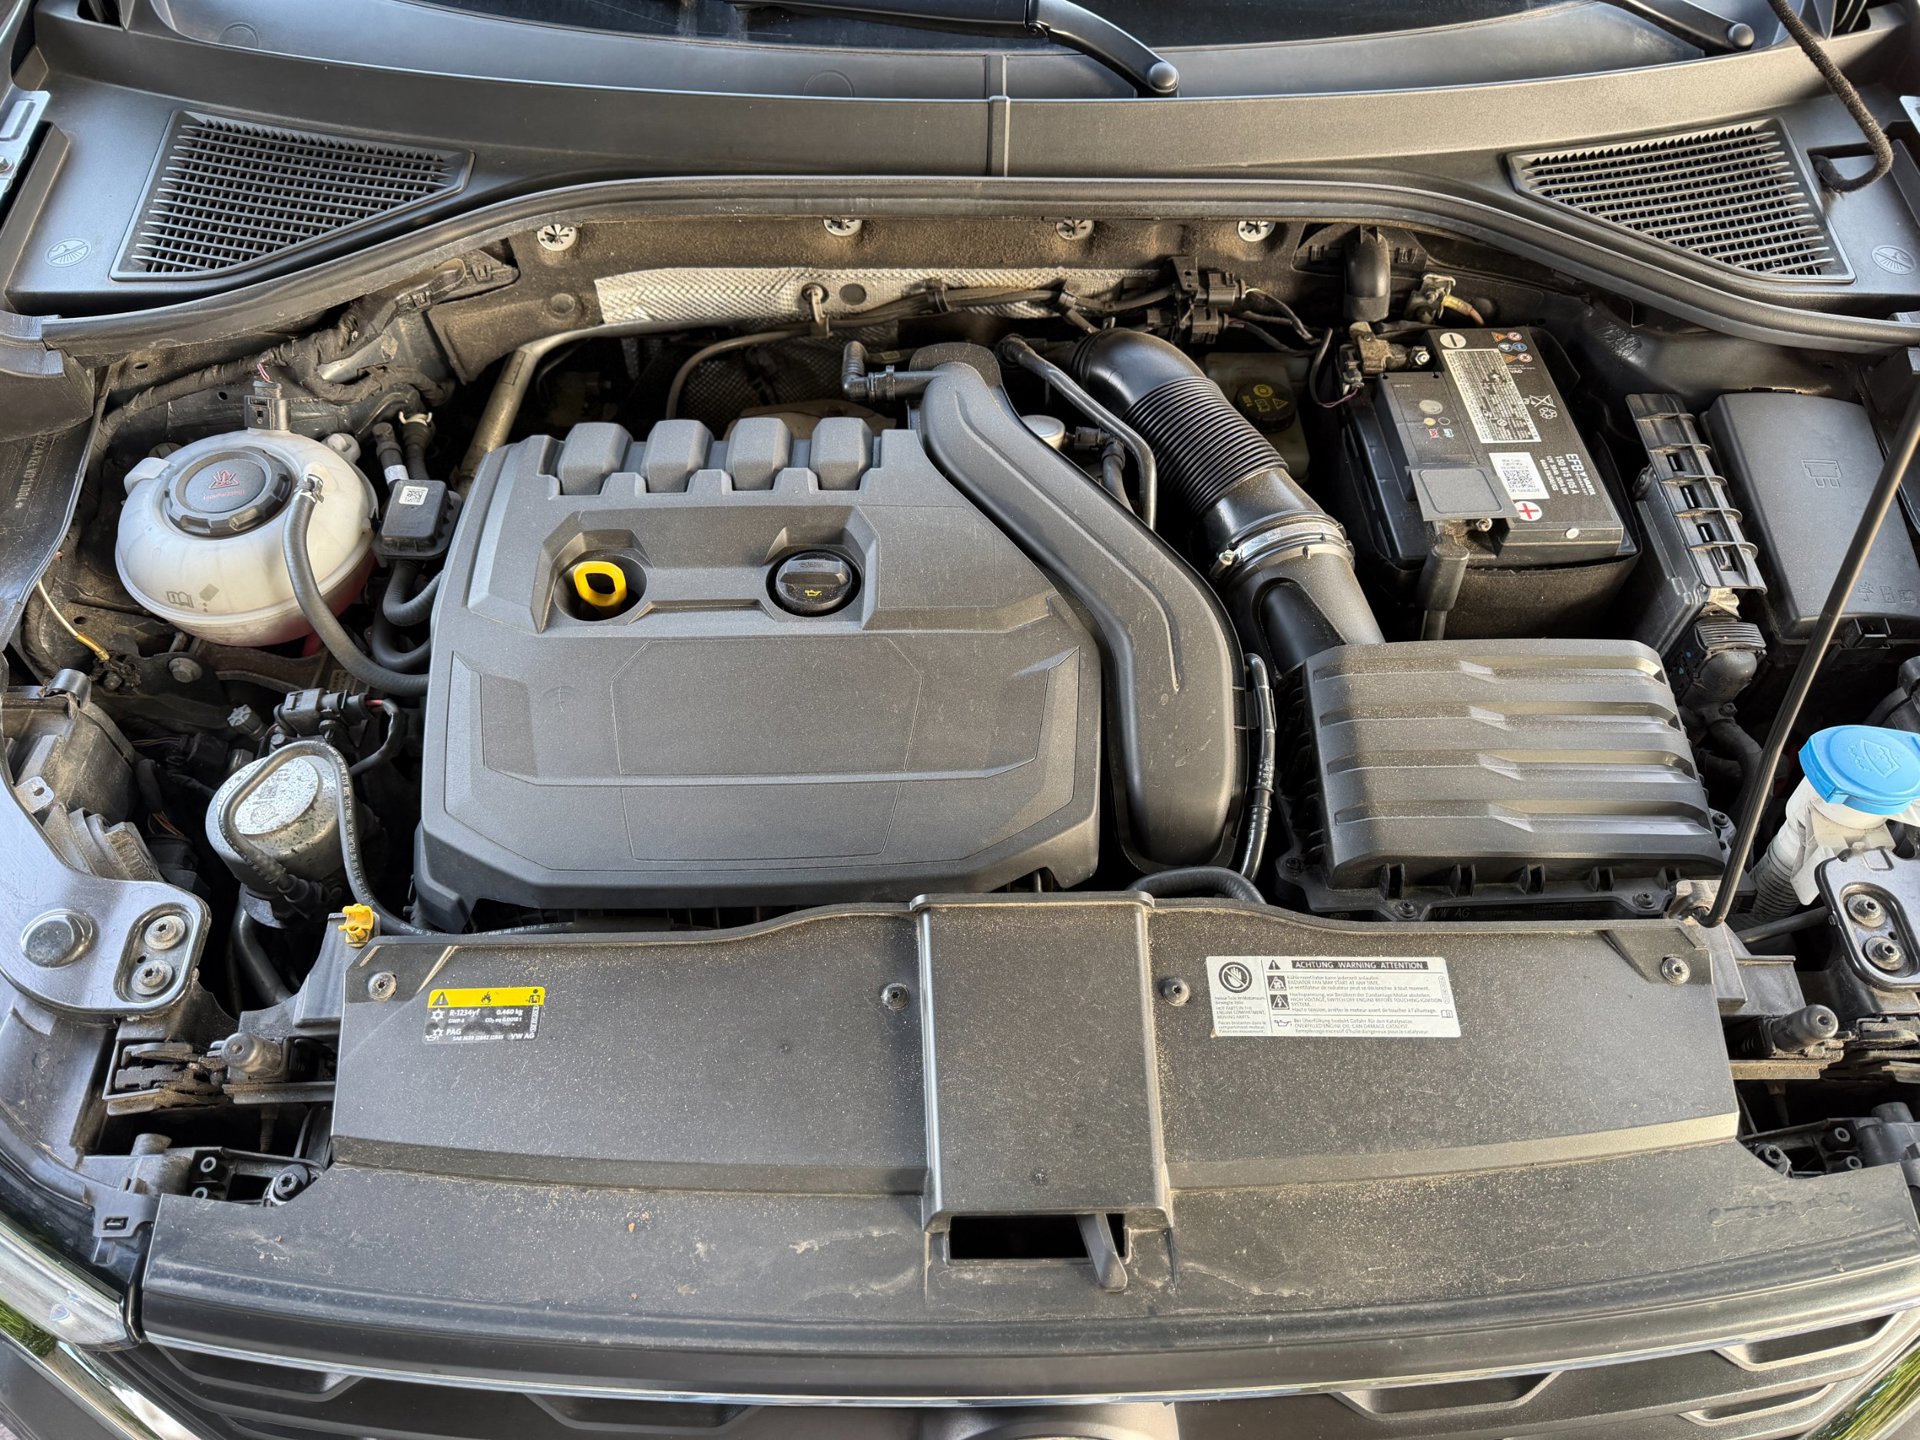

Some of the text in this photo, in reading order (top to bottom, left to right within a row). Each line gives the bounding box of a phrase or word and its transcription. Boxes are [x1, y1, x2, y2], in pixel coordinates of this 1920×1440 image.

[1565, 453, 1585, 472] EFB
[1295, 961, 1334, 969] ACHTUNG
[1338, 961, 1377, 969] WARNING
[449, 1008, 481, 1017] R-1234yf
[515, 1008, 524, 1016] kg
